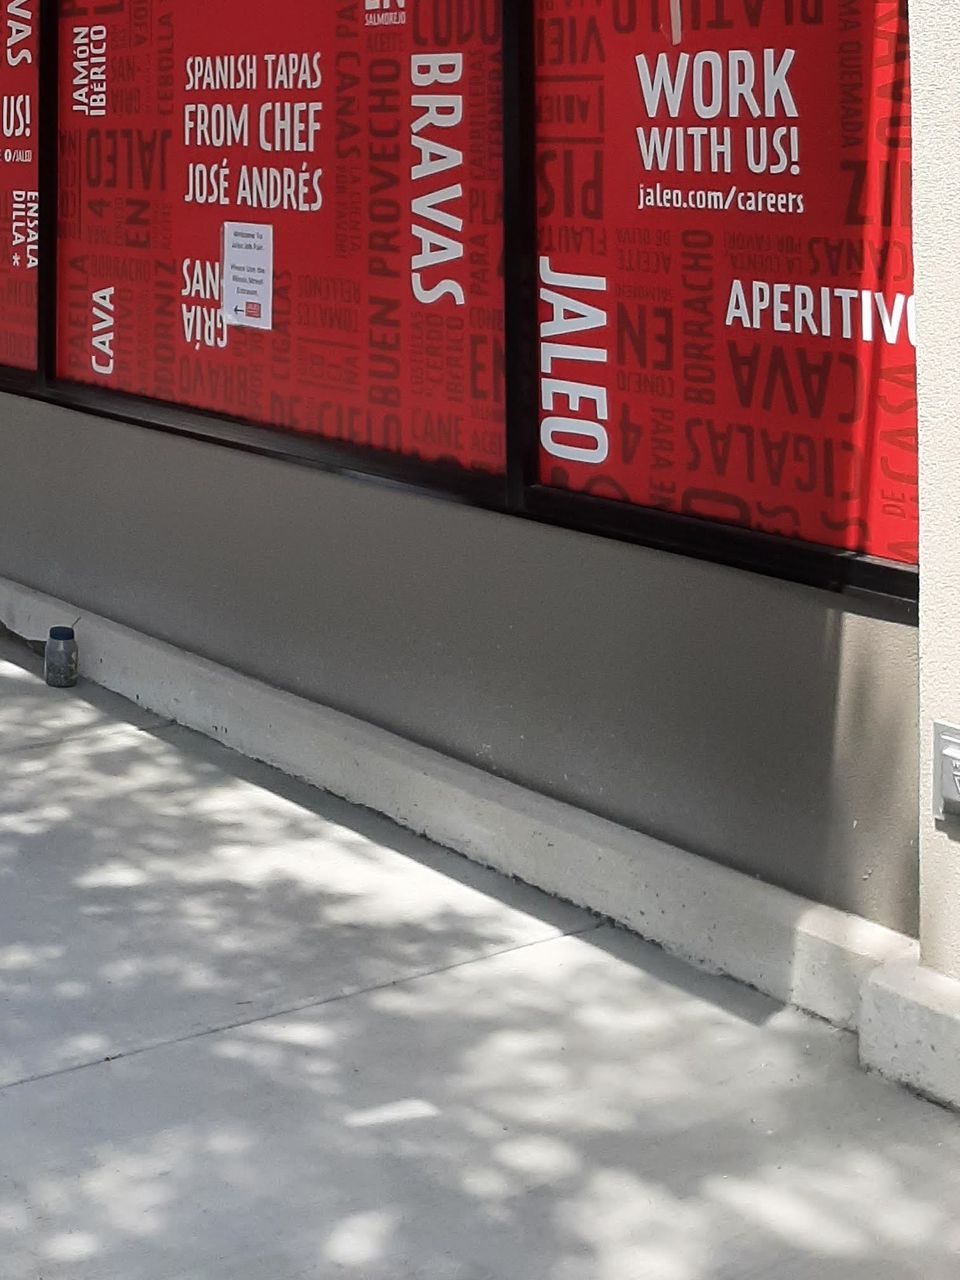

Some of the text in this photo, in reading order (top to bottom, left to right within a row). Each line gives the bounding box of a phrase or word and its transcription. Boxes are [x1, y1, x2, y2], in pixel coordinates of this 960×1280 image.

[72, 25, 90, 116] JAMÓN
[90, 24, 107, 117] IBÉRICO
[184, 54, 257, 91] SPANISH
[263, 50, 323, 90] TAPAS
[634, 48, 800, 119] WORK
[2, 94, 32, 137] US!
[184, 101, 323, 152] FROM CHEF
[86, 127, 173, 194] JALEO
[409, 51, 465, 306] BRAVAS
[636, 125, 801, 176] WITH US!
[11, 190, 26, 247] DILLA
[184, 158, 324, 214] JOSÉ ANDRÉS
[637, 182, 806, 214] jaleo.com/careers
[26, 190, 39, 269] ENSALA
[125, 197, 152, 250] EN
[368, 58, 401, 408] BUEN PROVECHO
[181, 257, 221, 302] SAN
[91, 284, 115, 376] CAVA
[181, 303, 228, 351] GRÍA
[616, 302, 674, 370] EN
[681, 227, 716, 406] BORRACHO
[539, 255, 610, 464] JALEO
[727, 340, 858, 424] CAVA
